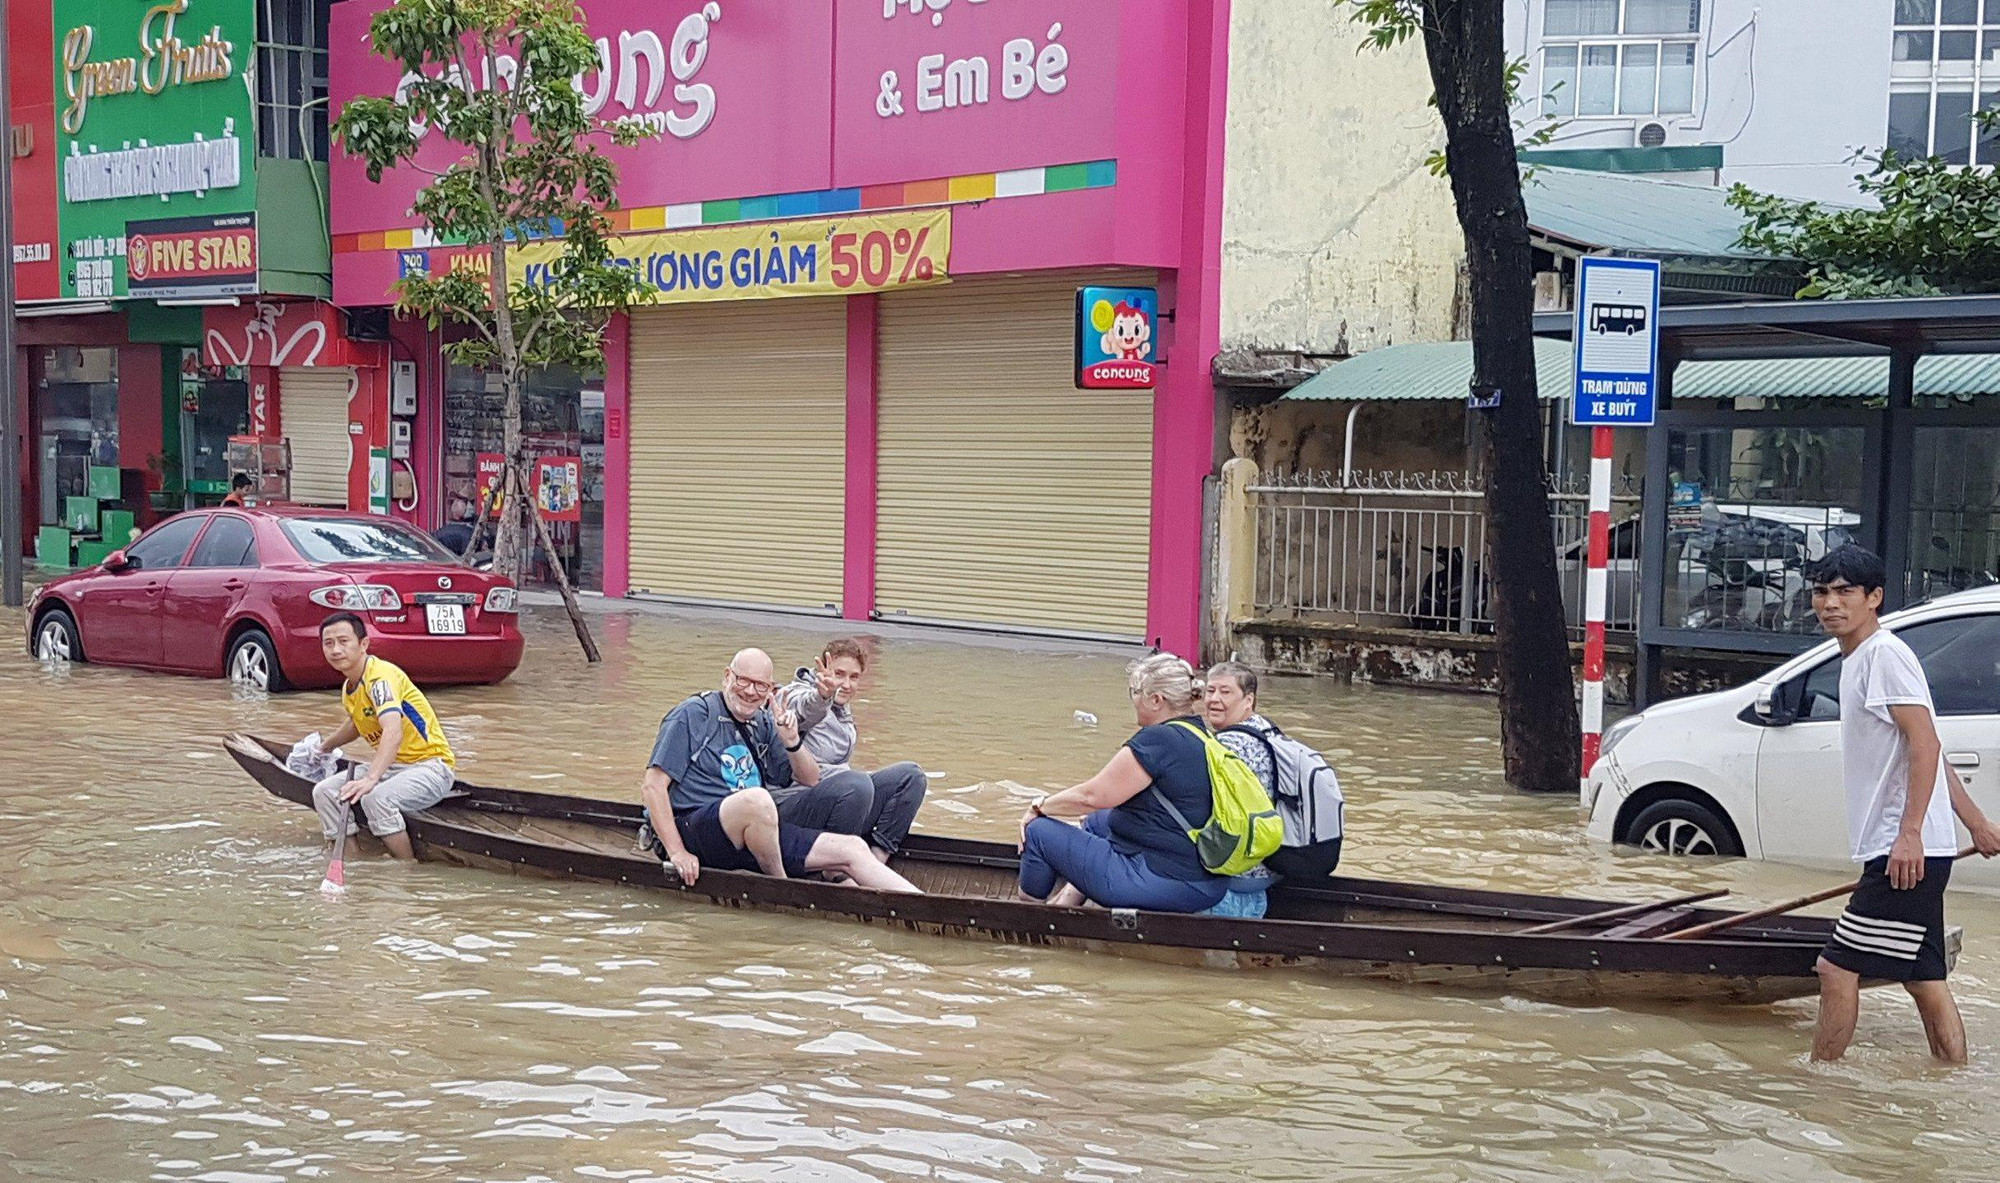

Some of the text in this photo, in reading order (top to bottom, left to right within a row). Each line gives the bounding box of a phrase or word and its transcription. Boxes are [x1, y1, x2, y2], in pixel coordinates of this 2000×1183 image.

[62, 0, 232, 134] Green Fruits
[875, 22, 1069, 117] & Em Bé
[152, 239, 195, 273] FIVE
[198, 235, 251, 271] STAR
[729, 231, 817, 289] GIẢM
[831, 227, 933, 289] 50%
[1094, 367, 1150, 383] concung
[1581, 379, 1612, 397] TRẠM
[1591, 398, 1637, 416] XE BUÝT
[436, 605, 455, 618] 75A
